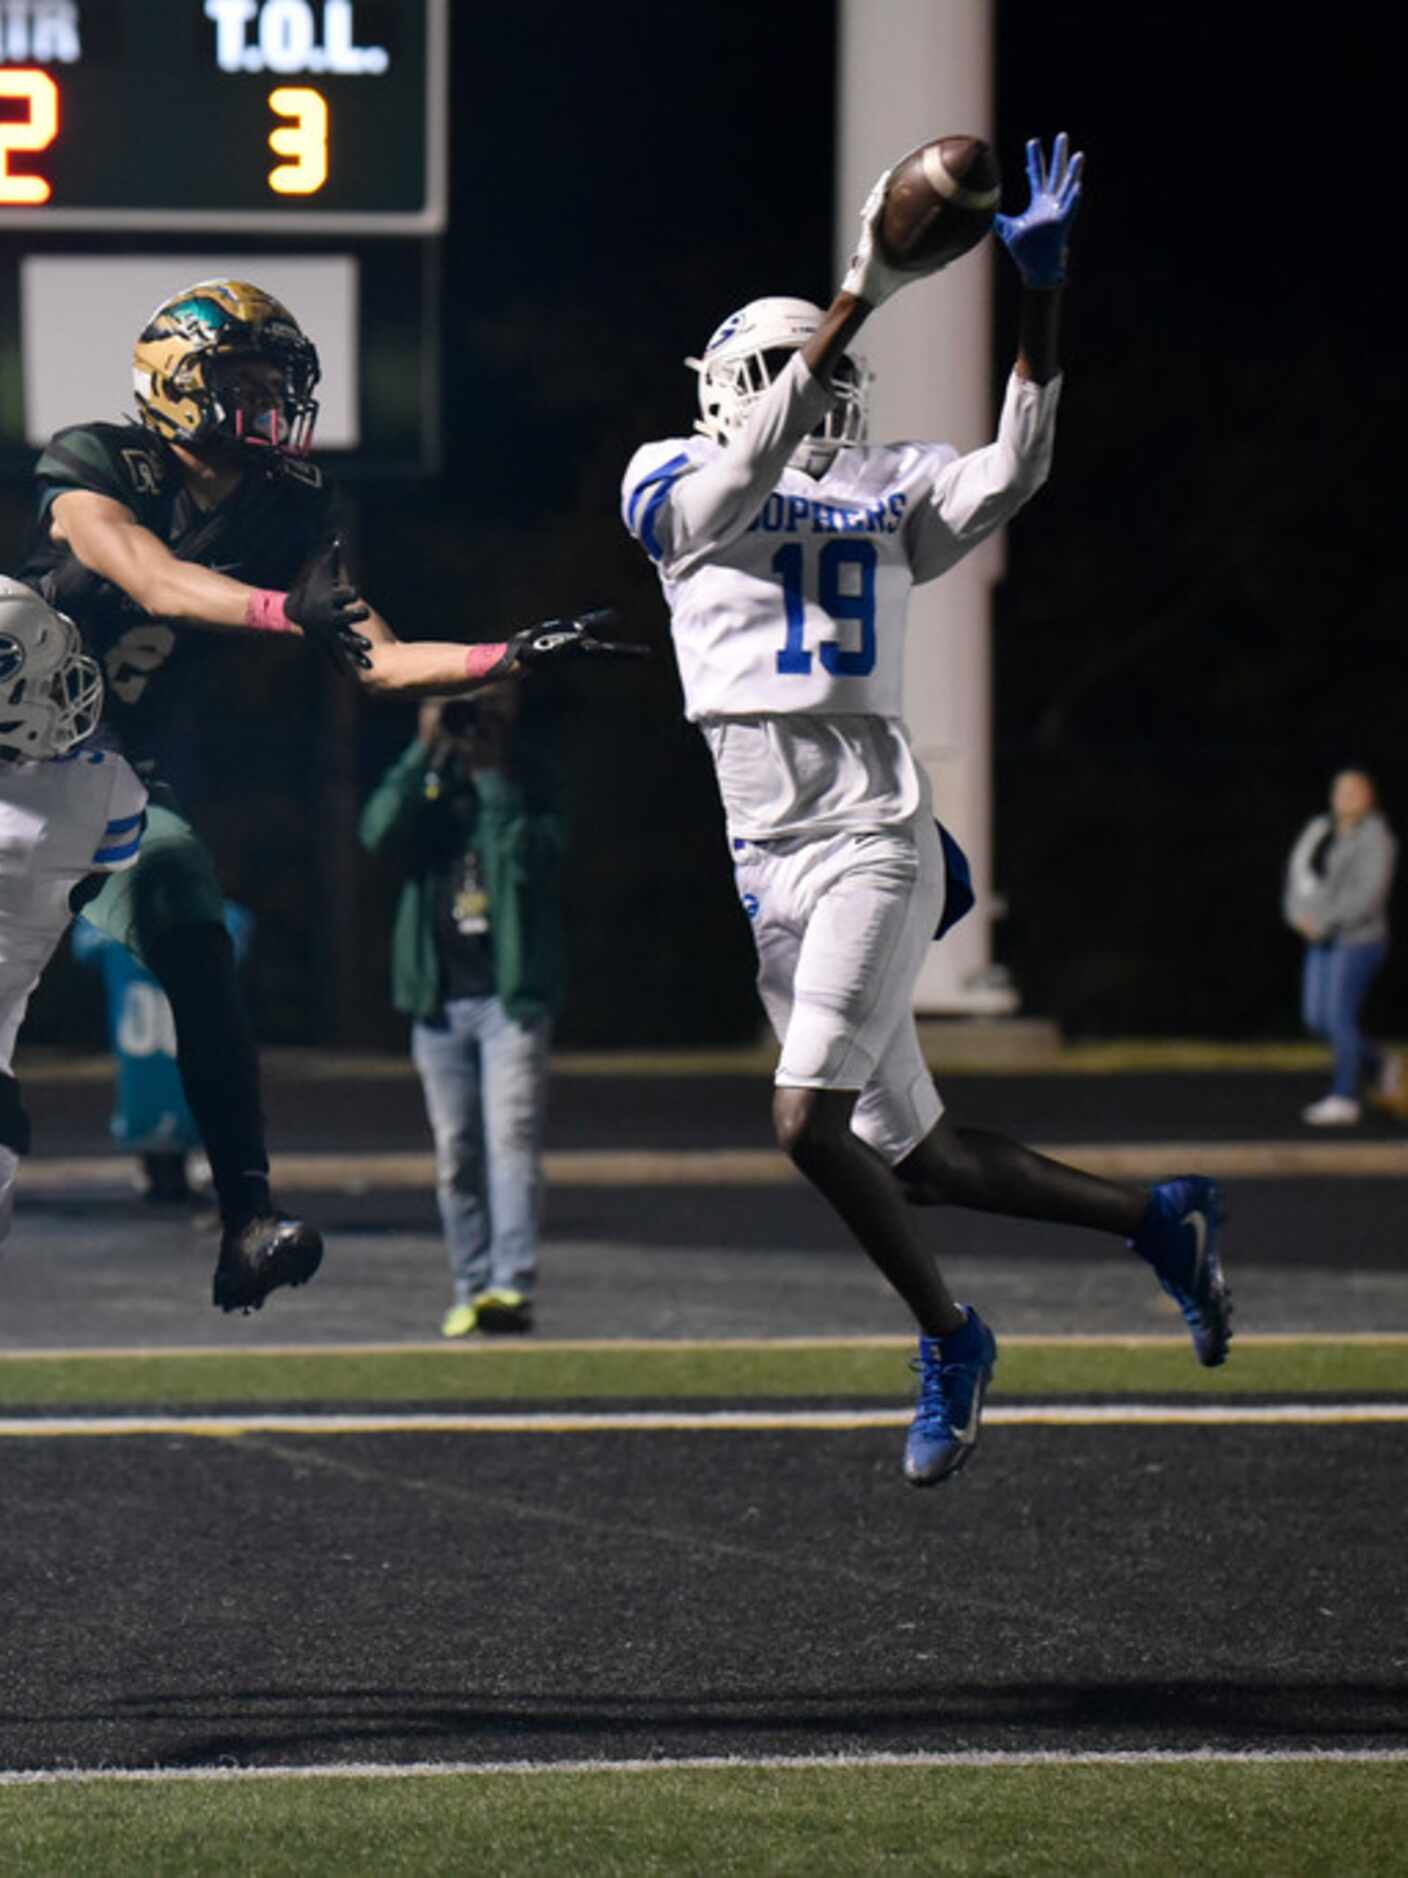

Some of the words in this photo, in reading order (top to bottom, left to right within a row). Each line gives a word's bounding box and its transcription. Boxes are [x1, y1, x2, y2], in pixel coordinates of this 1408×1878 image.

[204, 0, 389, 74] T.O.L.
[268, 86, 328, 195] 3
[750, 491, 907, 533] OPHERS
[772, 538, 878, 677] 19
